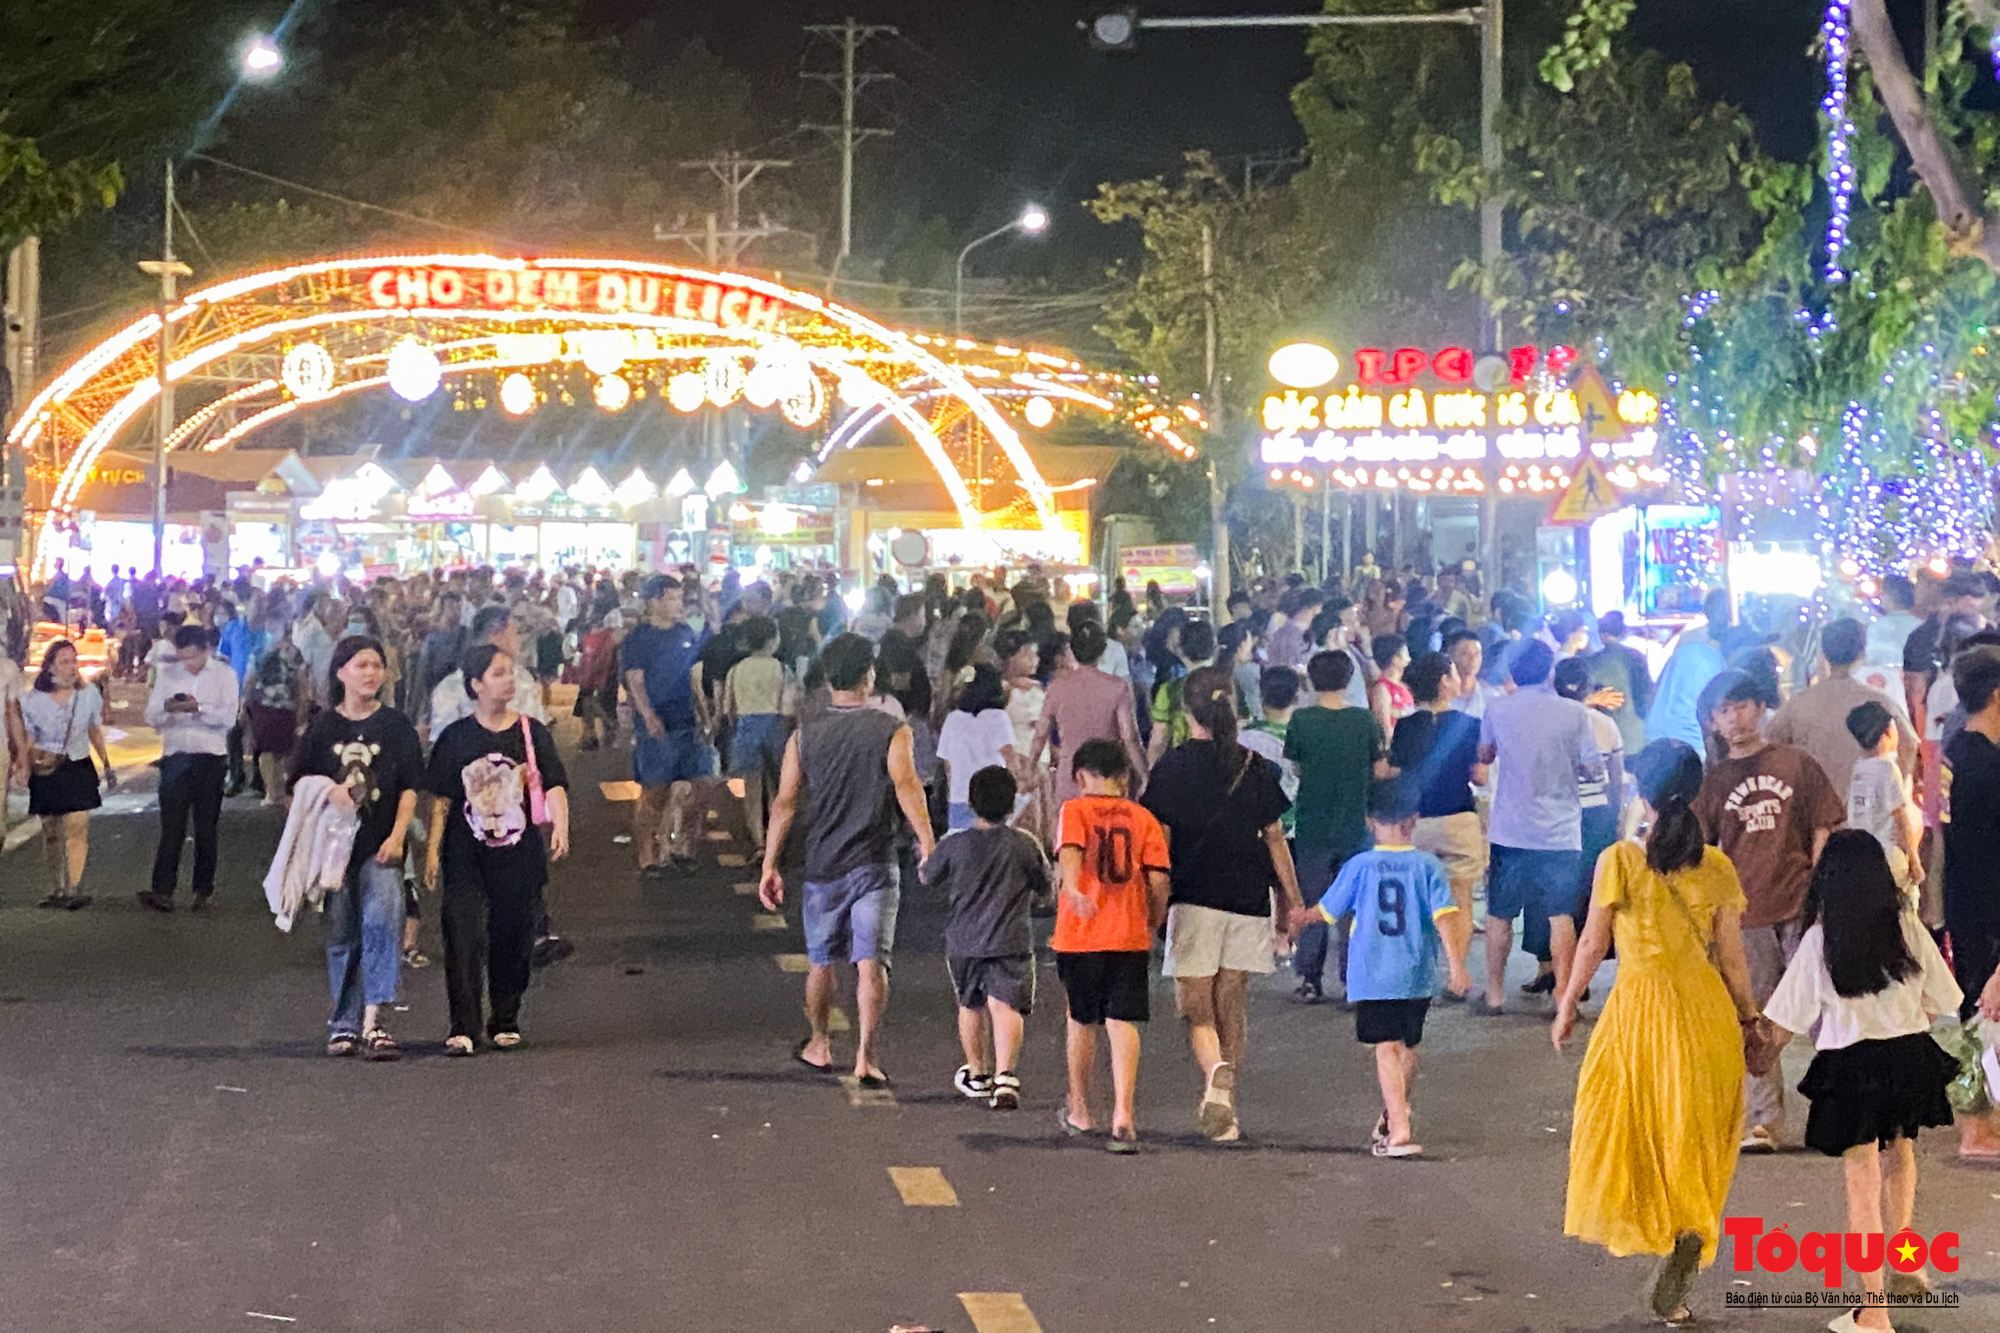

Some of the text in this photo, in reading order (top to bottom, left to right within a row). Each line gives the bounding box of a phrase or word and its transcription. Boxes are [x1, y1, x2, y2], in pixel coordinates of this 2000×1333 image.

[597, 274, 659, 313] DU
[1093, 824, 1133, 885] 10
[1378, 878, 1406, 936] 9
